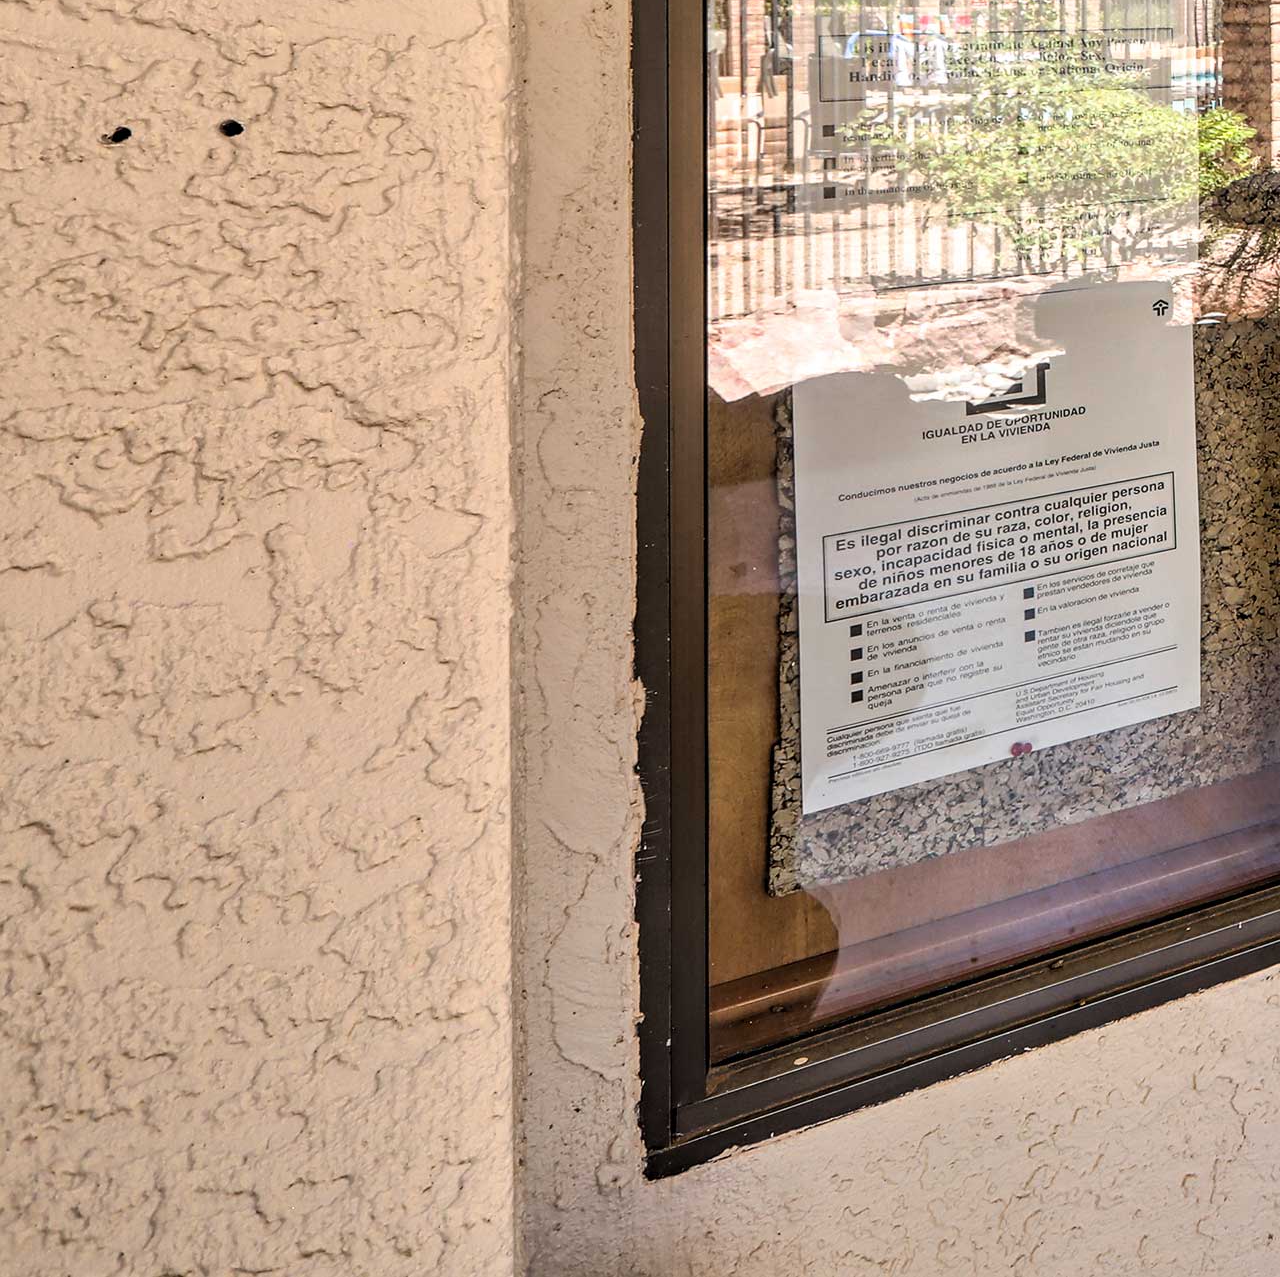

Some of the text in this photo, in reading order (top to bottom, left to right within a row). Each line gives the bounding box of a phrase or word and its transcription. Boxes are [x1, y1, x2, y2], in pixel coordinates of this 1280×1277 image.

[922, 422, 982, 440] IGUALDAD
[986, 419, 1001, 430] DE
[961, 423, 1050, 444] EN LA VIVIENDA
[838, 487, 895, 502] Conducimos
[898, 480, 936, 491] nuestros
[939, 473, 978, 484] negocios
[993, 464, 1026, 475] acuerdo
[1061, 452, 1090, 463] Federal
[1104, 445, 1137, 455] Vivienda
[1138, 441, 1159, 449] Justa
[835, 508, 1166, 580] sexo, incapacidad fisica o mental, la presencia
[836, 539, 855, 551] Es
[861, 529, 901, 547] ilegal
[907, 515, 990, 538] discriminar
[995, 506, 1039, 522] contra
[1044, 494, 1107, 512] cualquier
[1112, 483, 1164, 502] persona
[876, 502, 1131, 559] por razon de su raza, color, religion,
[835, 533, 1166, 609] embarazada en su familia o su origen nacional
[858, 525, 1148, 590] de niños menores de 18 años o de mujer
